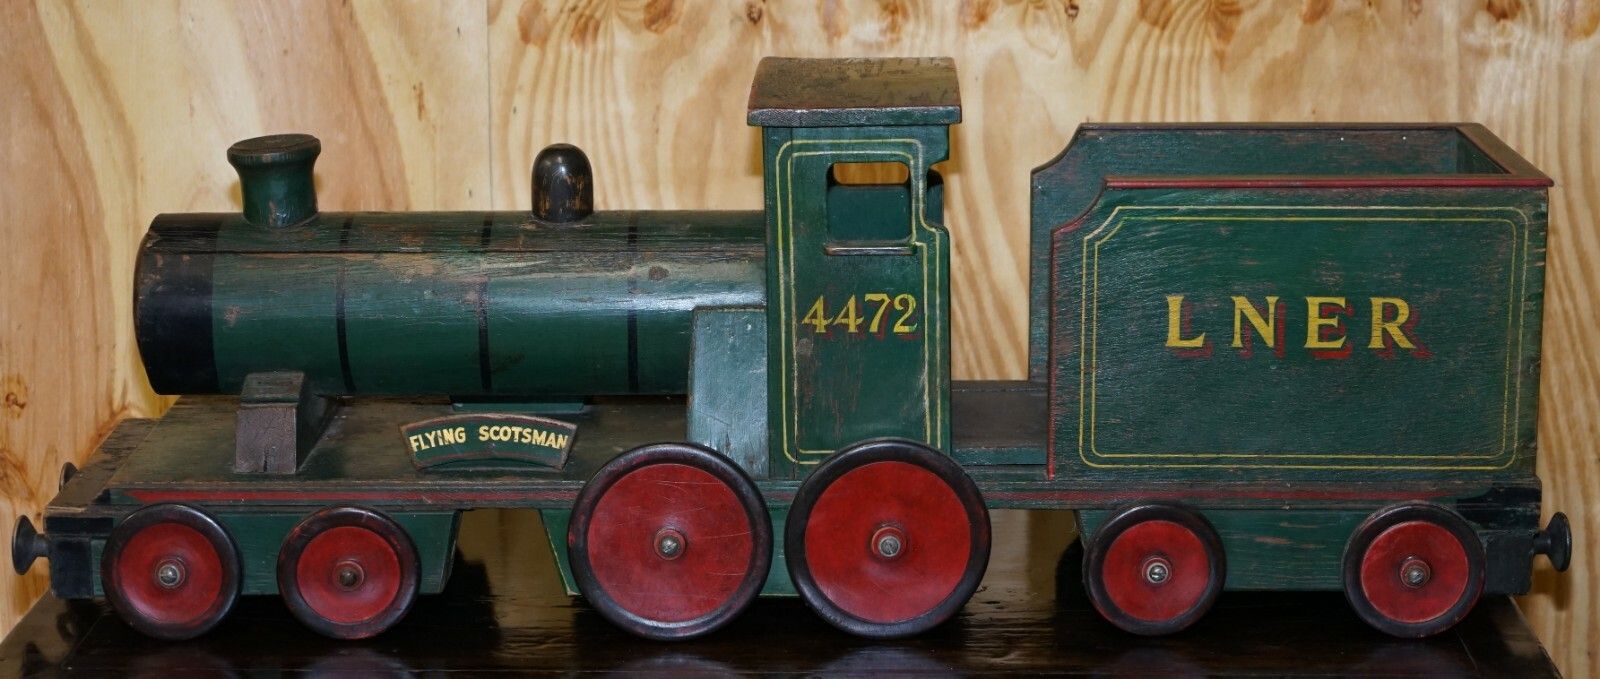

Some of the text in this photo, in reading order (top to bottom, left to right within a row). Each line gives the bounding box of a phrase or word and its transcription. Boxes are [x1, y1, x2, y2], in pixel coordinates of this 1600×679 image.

[801, 293, 918, 333] 4472
[1165, 294, 1418, 350] LNER
[409, 425, 569, 452] FLYING SCOTSMAN
